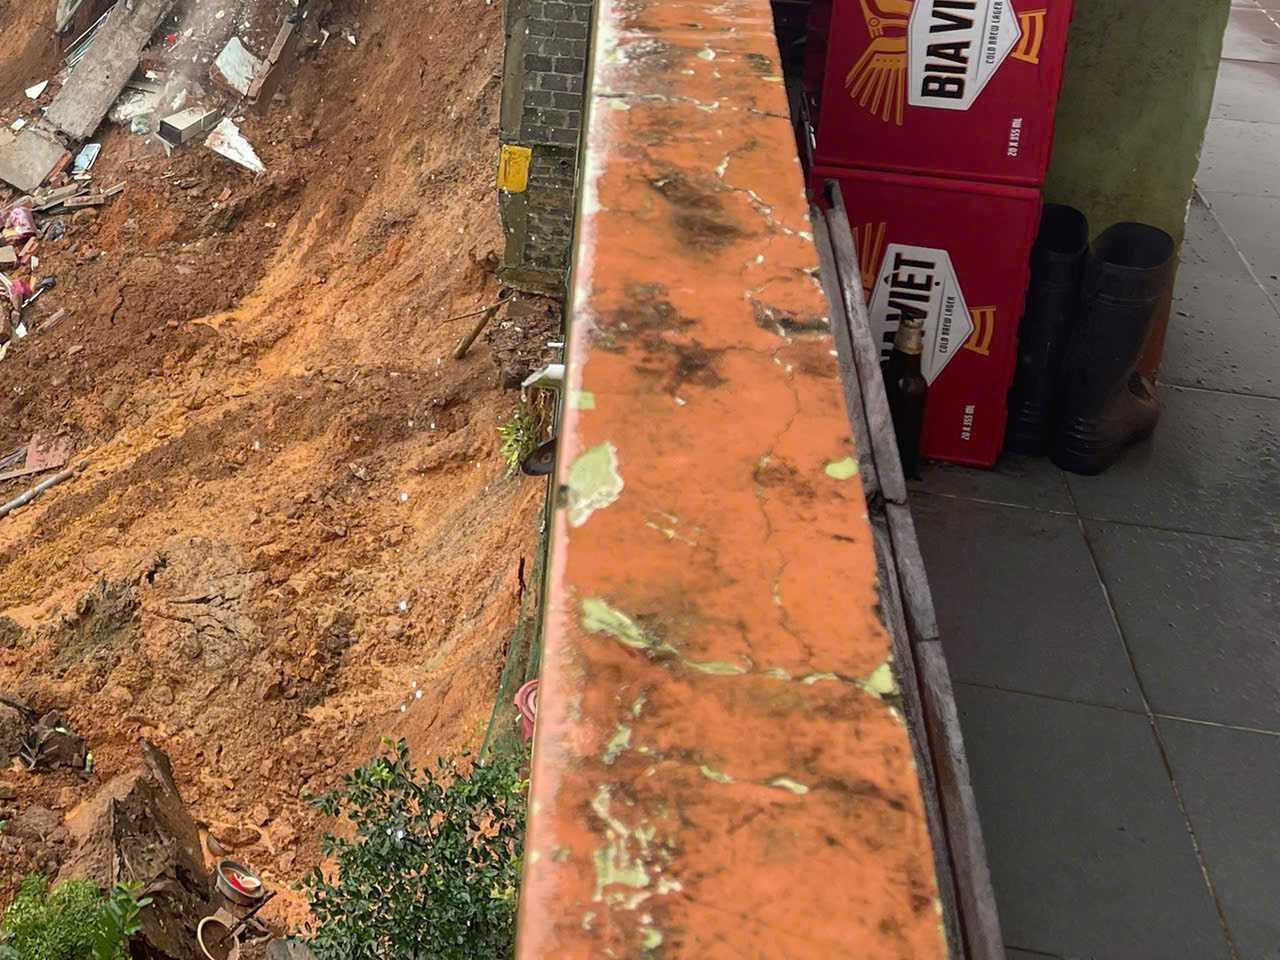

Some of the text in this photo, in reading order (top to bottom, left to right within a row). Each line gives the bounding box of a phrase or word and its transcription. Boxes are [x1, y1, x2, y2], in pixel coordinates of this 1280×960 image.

[985, 1, 1003, 64] COLD BREW LAGER
[920, 41, 971, 99] BIA
[1007, 147, 1018, 157] 20
[1010, 128, 1021, 141] 355
[938, 296, 956, 353] COLD BREW LAGER
